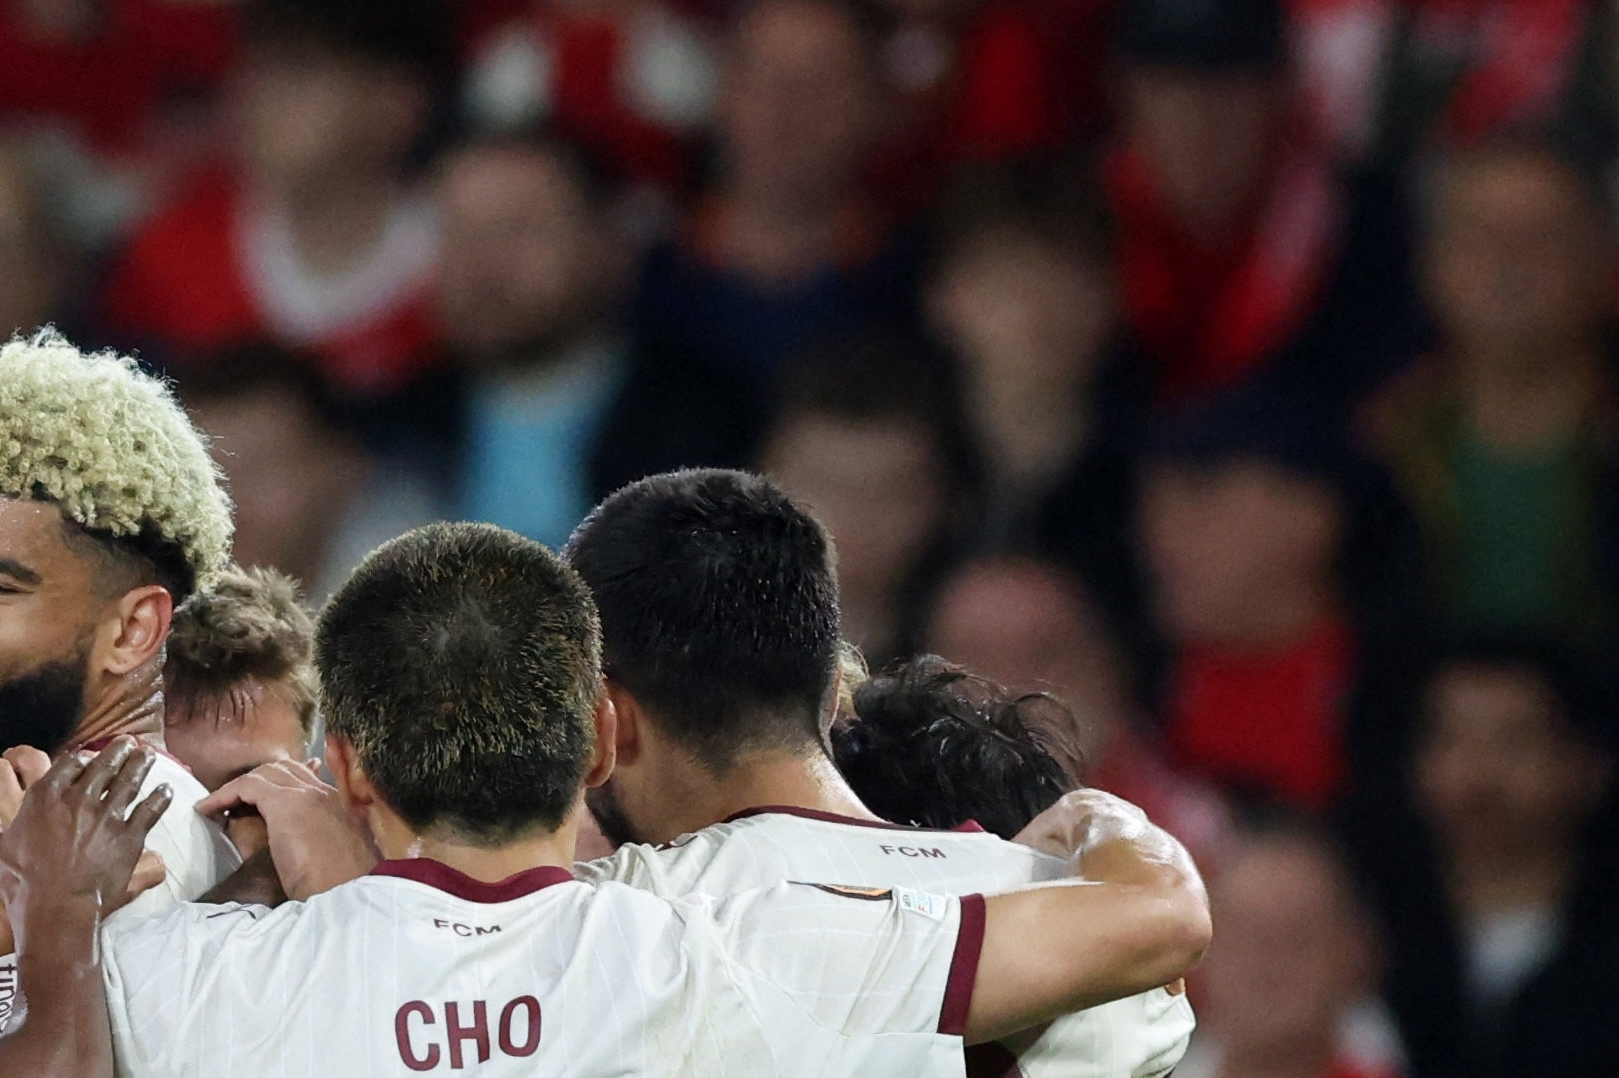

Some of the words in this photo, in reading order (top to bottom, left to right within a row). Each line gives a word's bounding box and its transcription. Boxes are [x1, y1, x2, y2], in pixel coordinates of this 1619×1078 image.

[879, 845, 947, 859] FCM
[433, 918, 502, 938] FCM
[394, 995, 542, 1072] CHO
